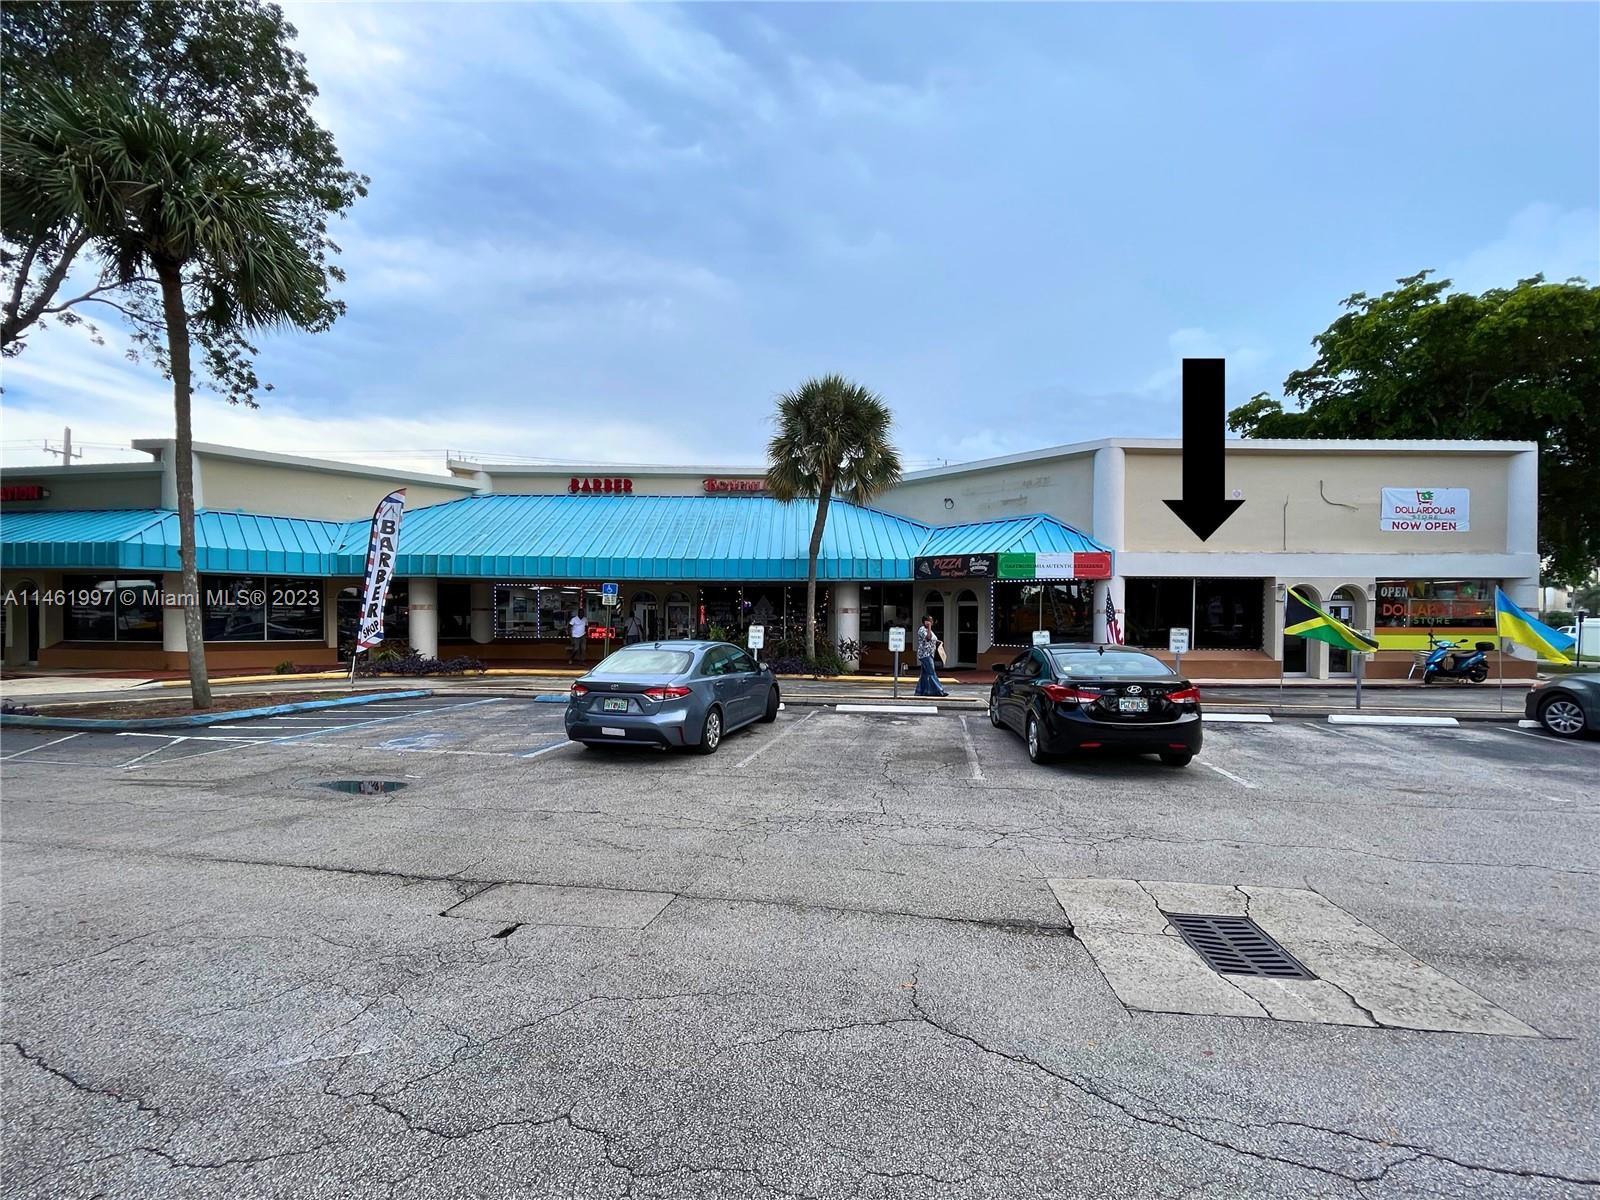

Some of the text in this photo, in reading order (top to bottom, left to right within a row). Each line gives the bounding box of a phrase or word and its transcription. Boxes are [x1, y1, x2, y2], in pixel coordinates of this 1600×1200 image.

[568, 477, 633, 494] BARBER
[1395, 506, 1456, 515] DOLLARDOLAR
[1392, 521, 1457, 531] NOW OPEN
[366, 519, 396, 618] BARBER
[933, 557, 963, 570] PIZZA
[1381, 586, 1409, 598] OPEN
[1413, 616, 1451, 625] STORE
[362, 620, 380, 639] SHOP
